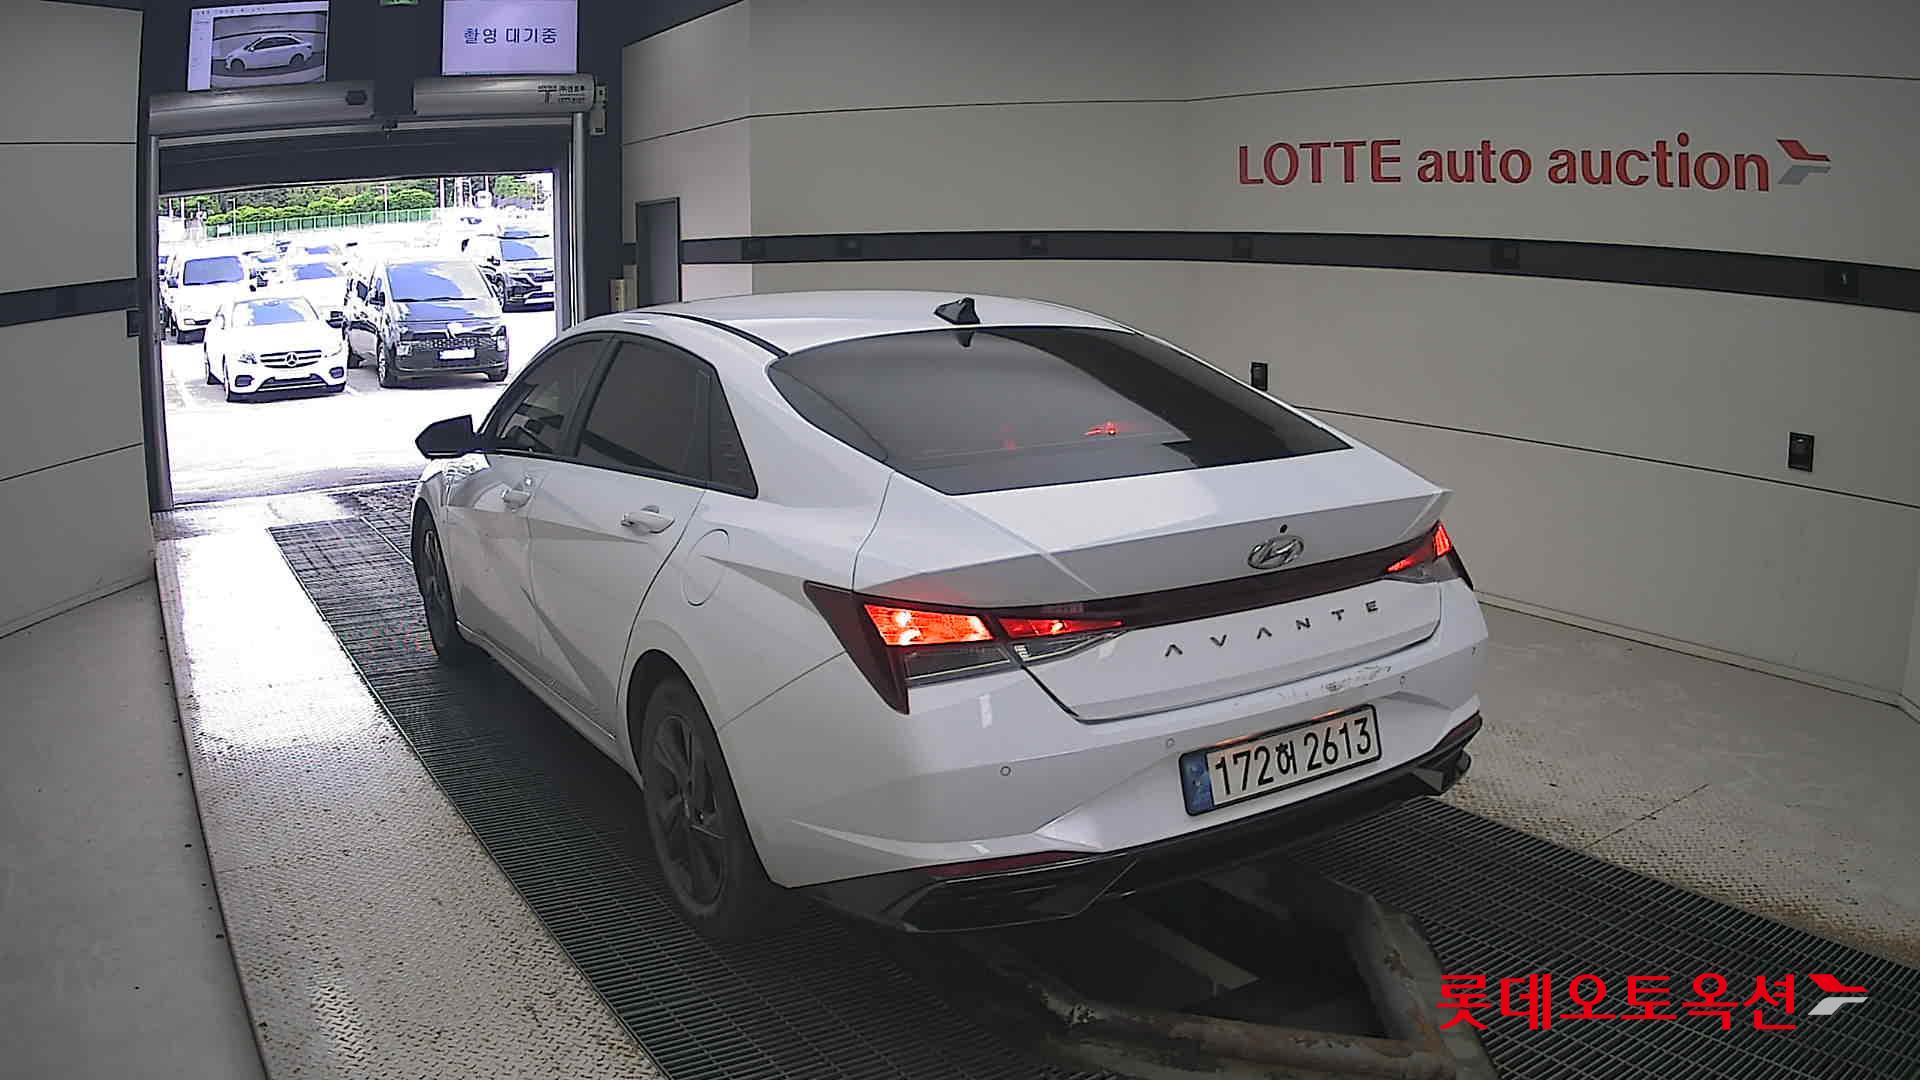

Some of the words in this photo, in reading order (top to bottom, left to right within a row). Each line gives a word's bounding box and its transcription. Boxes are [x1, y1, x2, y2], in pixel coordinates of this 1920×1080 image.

[464, 27, 497, 44] 촬영
[505, 27, 558, 44] 대기중
[1238, 139, 1401, 185] LOTTE
[1417, 140, 1532, 184] auto
[1548, 132, 1770, 192] auction
[1164, 600, 1379, 657] AVANTE
[1215, 740, 1298, 796] 172허
[1303, 716, 1372, 772] 2613
